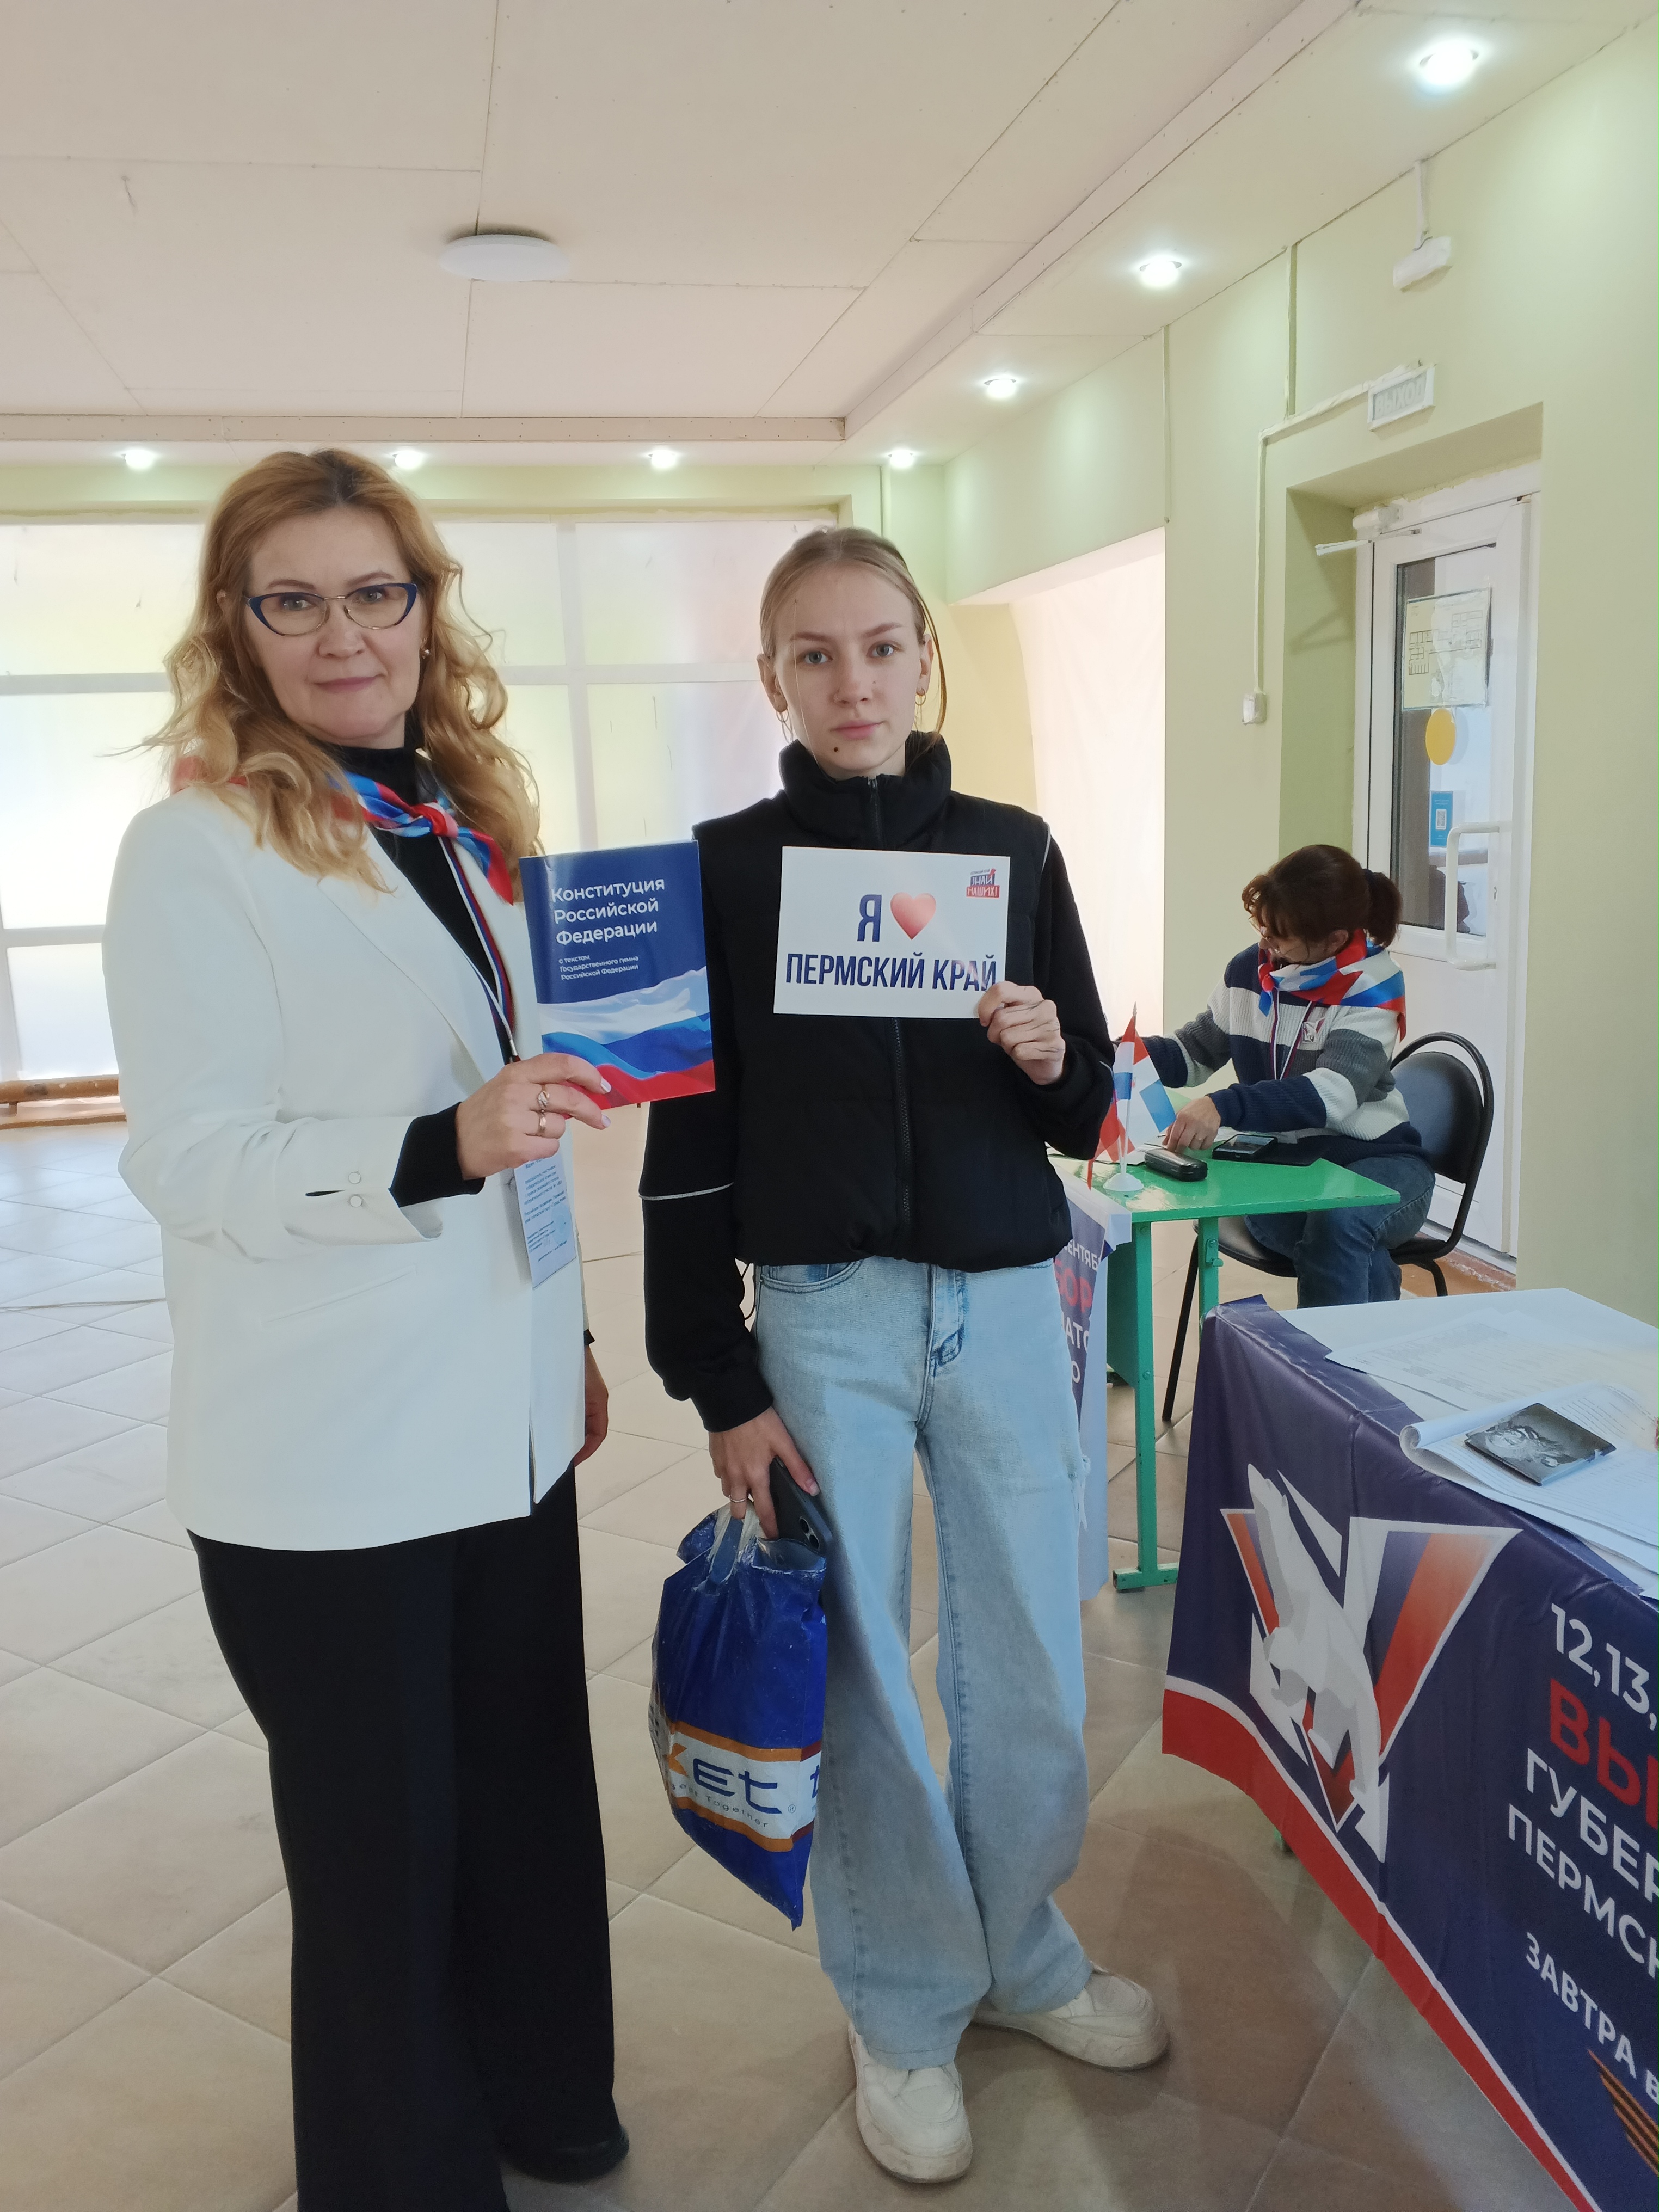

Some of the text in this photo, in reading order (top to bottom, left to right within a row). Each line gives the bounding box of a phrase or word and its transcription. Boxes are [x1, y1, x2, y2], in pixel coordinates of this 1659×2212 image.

[1375, 376, 1425, 417] ВЫХОД
[550, 878, 665, 902] Конституция
[554, 897, 659, 924] Российской
[857, 894, 882, 942] Я
[556, 921, 658, 945] Федерации
[560, 959, 618, 973] Государственного
[561, 964, 639, 980] Российской Федерации
[564, 955, 591, 963] текстом
[785, 951, 997, 992] ПЕРМСКИЙ КРАЙ
[1064, 1240, 1101, 1272] ЕНТЯБ
[1526, 1932, 1637, 2079] ЗАВТРА
